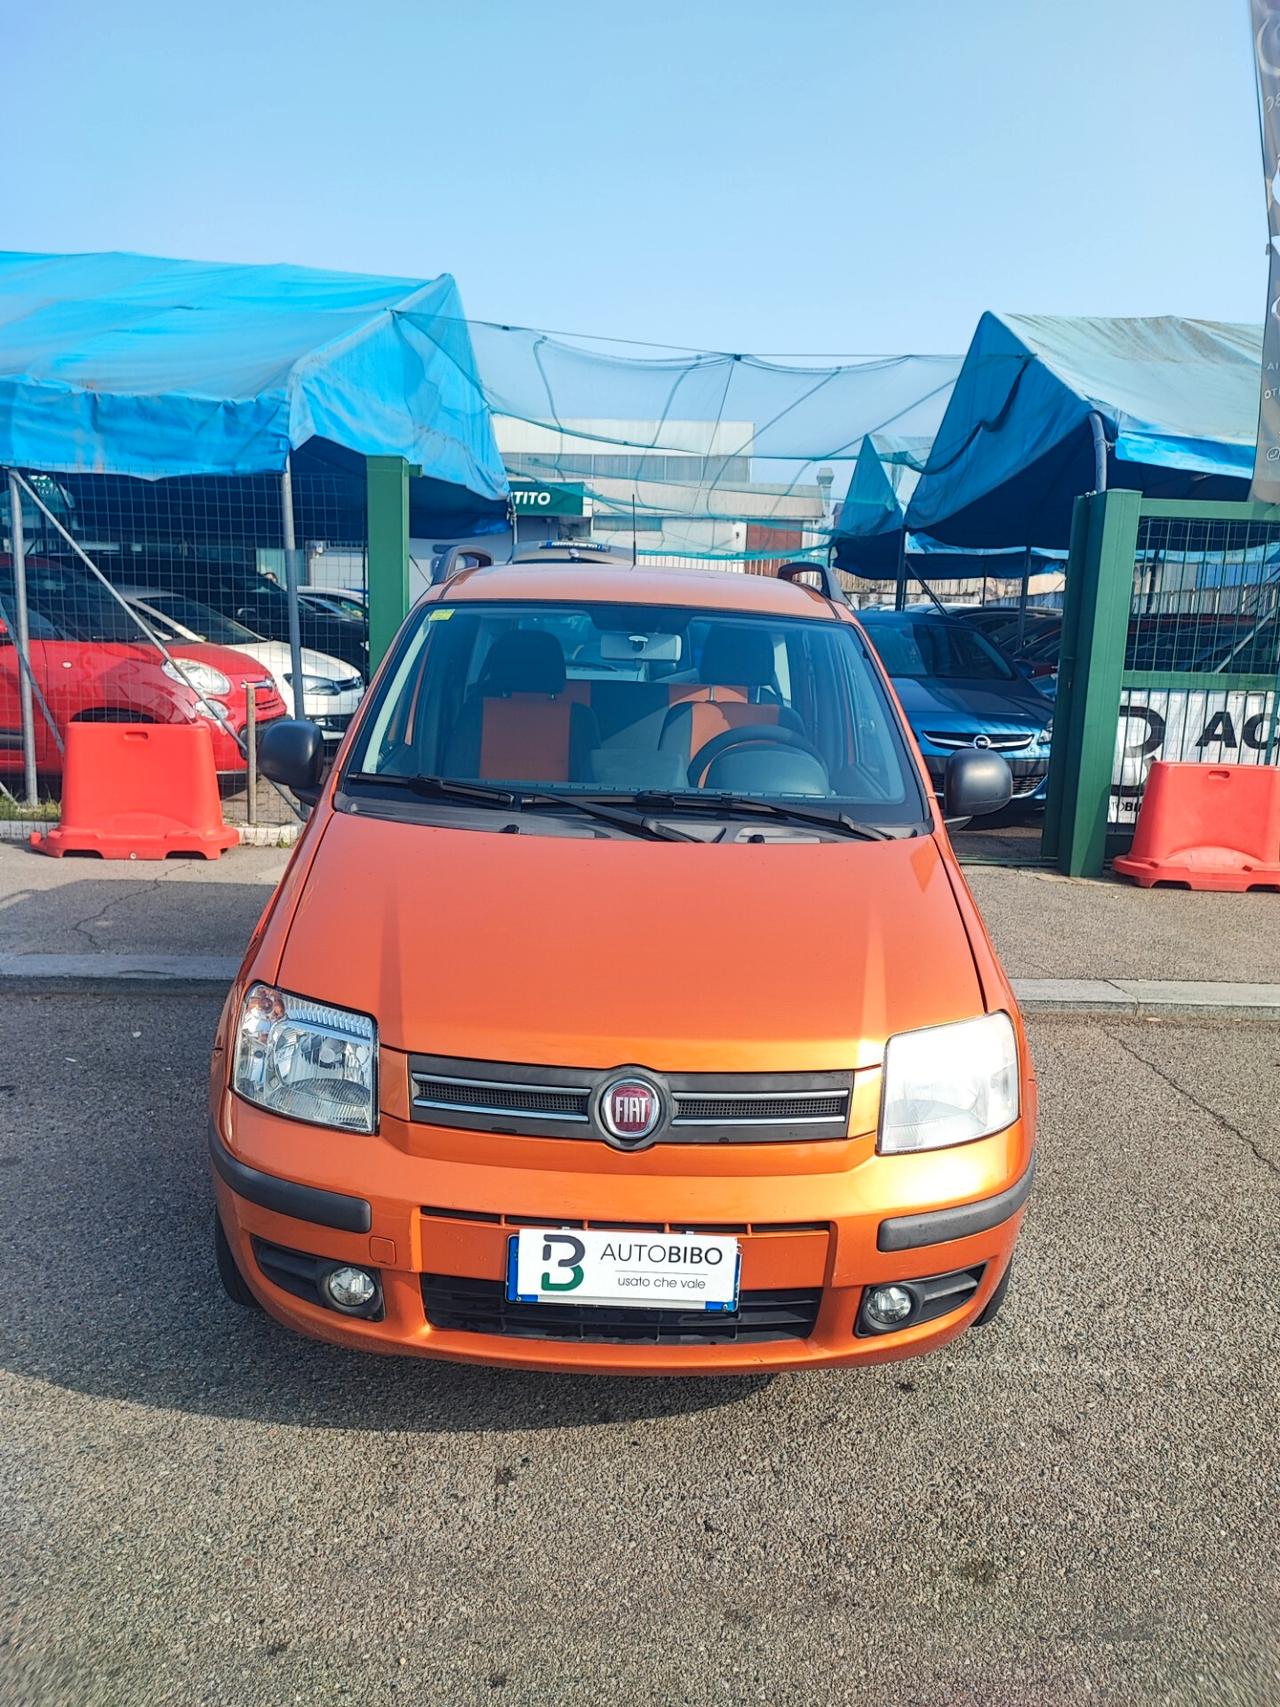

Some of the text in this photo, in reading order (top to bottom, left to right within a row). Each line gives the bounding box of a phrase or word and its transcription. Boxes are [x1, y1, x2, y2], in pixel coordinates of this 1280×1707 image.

[511, 491, 551, 506] TITO
[615, 1096, 649, 1123] FIAT
[600, 1243, 723, 1266] AUTOBIBO
[617, 1276, 706, 1289] usato che vale
